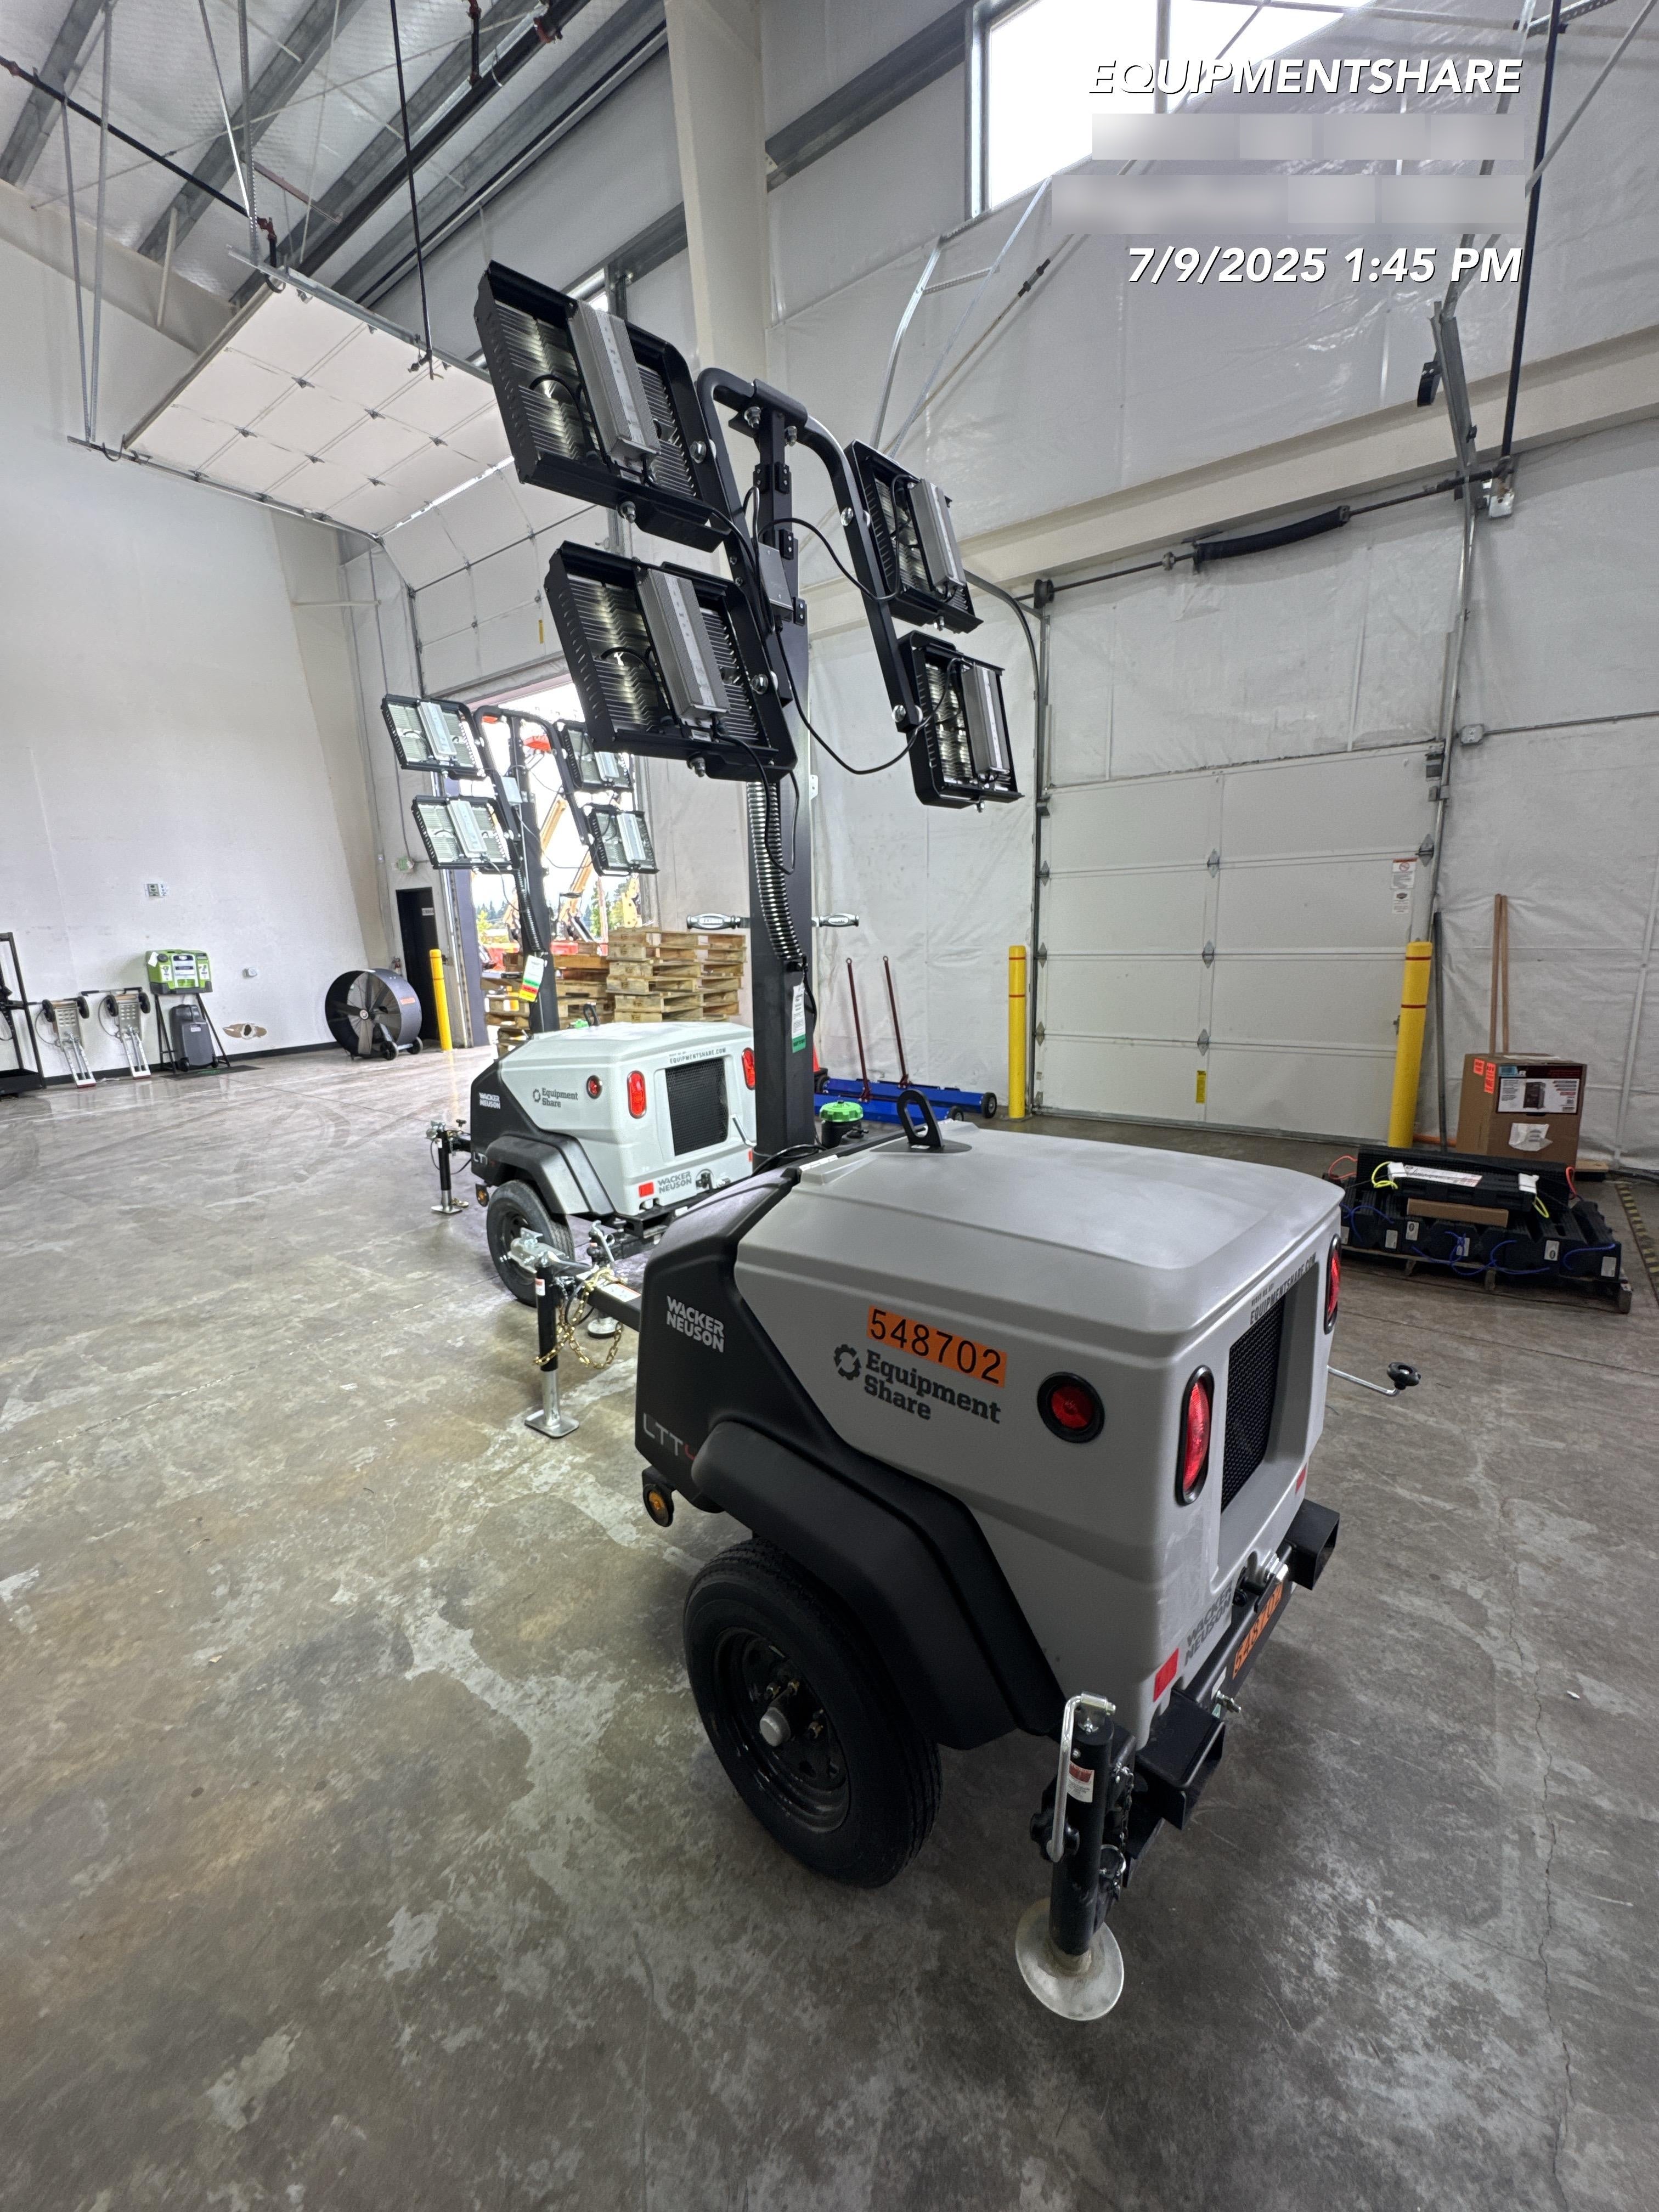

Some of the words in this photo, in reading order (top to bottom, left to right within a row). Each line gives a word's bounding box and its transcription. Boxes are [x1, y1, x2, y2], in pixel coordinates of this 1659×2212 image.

[542, 1087, 578, 1100] Equipment
[542, 1097, 561, 1108] Share
[657, 1171, 691, 1186] WACKER
[658, 1177, 692, 1193] NEUSON
[667, 1295, 724, 1338] WACKER
[667, 1311, 724, 1352] NEUSON
[870, 1310, 1002, 1384] 548702
[864, 1373, 931, 1420] Share
[866, 1350, 1001, 1424] Equipment
[1184, 1593, 1232, 1666] NEUSON
[1187, 1580, 1233, 1647] WACKER
